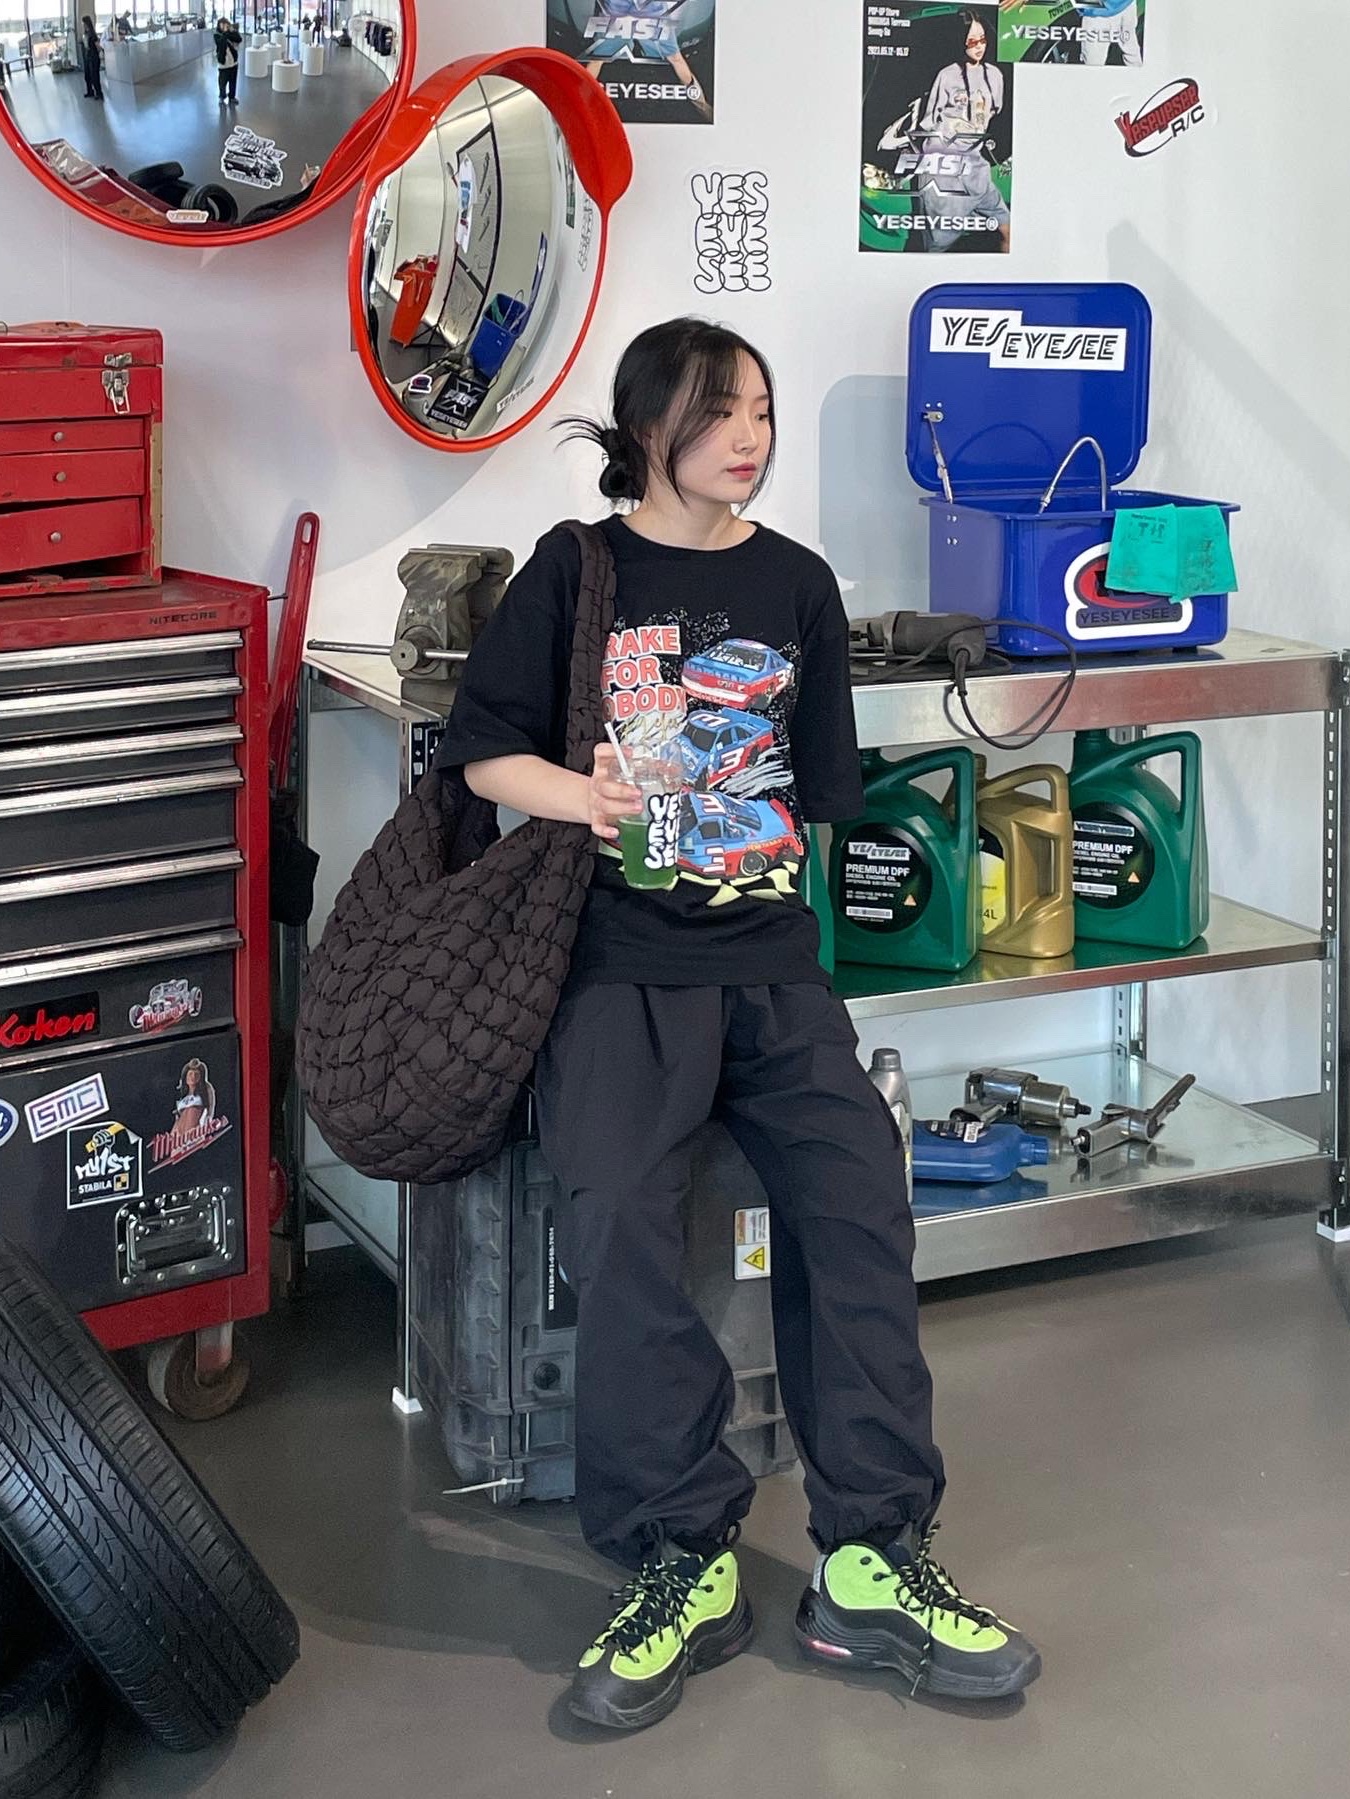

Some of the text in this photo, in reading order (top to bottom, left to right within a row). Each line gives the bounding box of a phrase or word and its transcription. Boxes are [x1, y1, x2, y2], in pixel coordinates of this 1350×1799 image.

[584, 16, 677, 40] FAST
[1171, 105, 1205, 137] R/C
[894, 152, 977, 175] FAST
[691, 171, 769, 219] YES
[694, 211, 769, 257] EYE
[693, 250, 772, 294] SEE
[149, 610, 217, 625] NITECORE
[601, 655, 662, 692] FOR
[717, 747, 745, 775] 3
[702, 846, 727, 873] 3
[1072, 840, 1134, 855] PREMIUM DPF
[845, 863, 911, 877] PREMIUM DPF
[0, 1009, 95, 1049] Koken
[37, 1087, 98, 1129] SMC
[79, 1179, 112, 1194] STABILA
